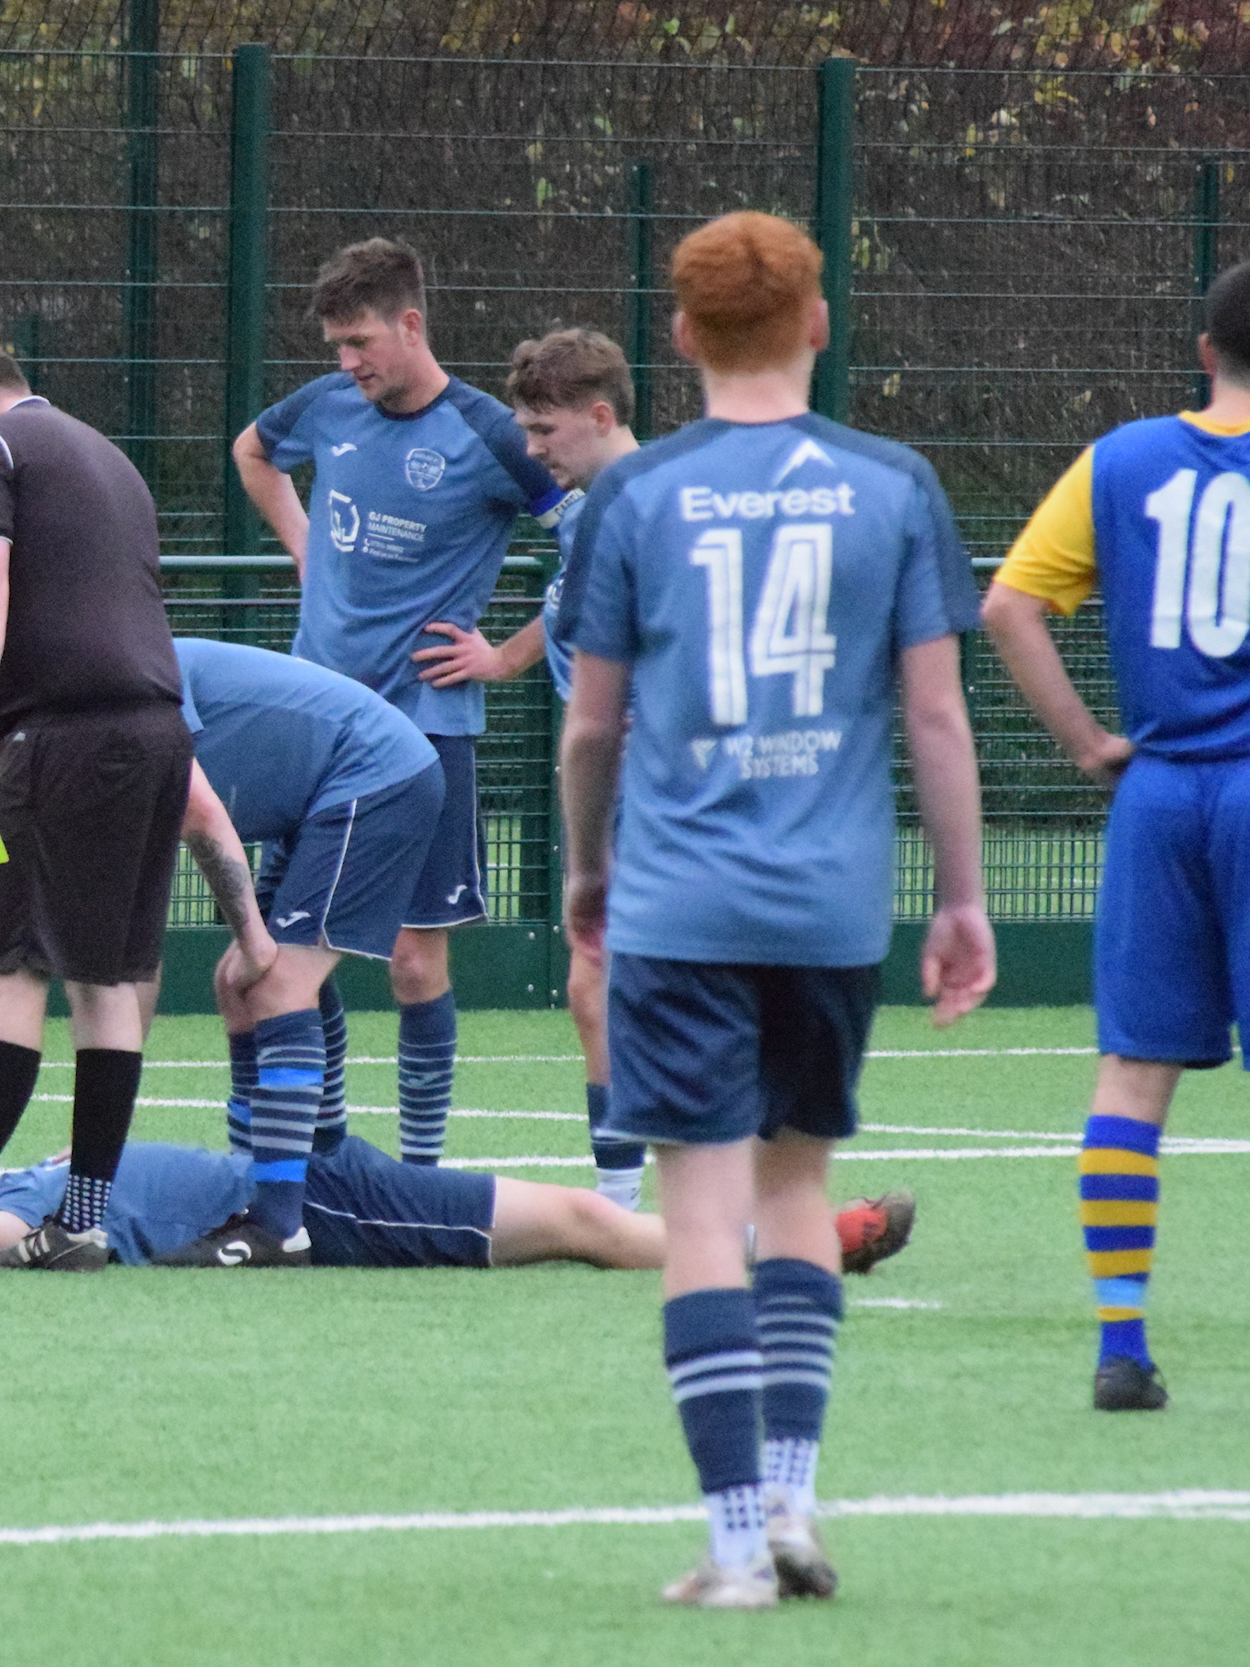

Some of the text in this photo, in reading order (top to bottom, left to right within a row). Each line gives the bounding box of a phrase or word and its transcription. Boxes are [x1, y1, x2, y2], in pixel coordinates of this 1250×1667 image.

[680, 483, 856, 521] Everest
[382, 514, 427, 533] PROPERTY
[1145, 467, 1250, 658] 10
[690, 523, 837, 726] 14
[758, 730, 842, 756] WINDOW
[740, 752, 820, 780] SYSTEMS
